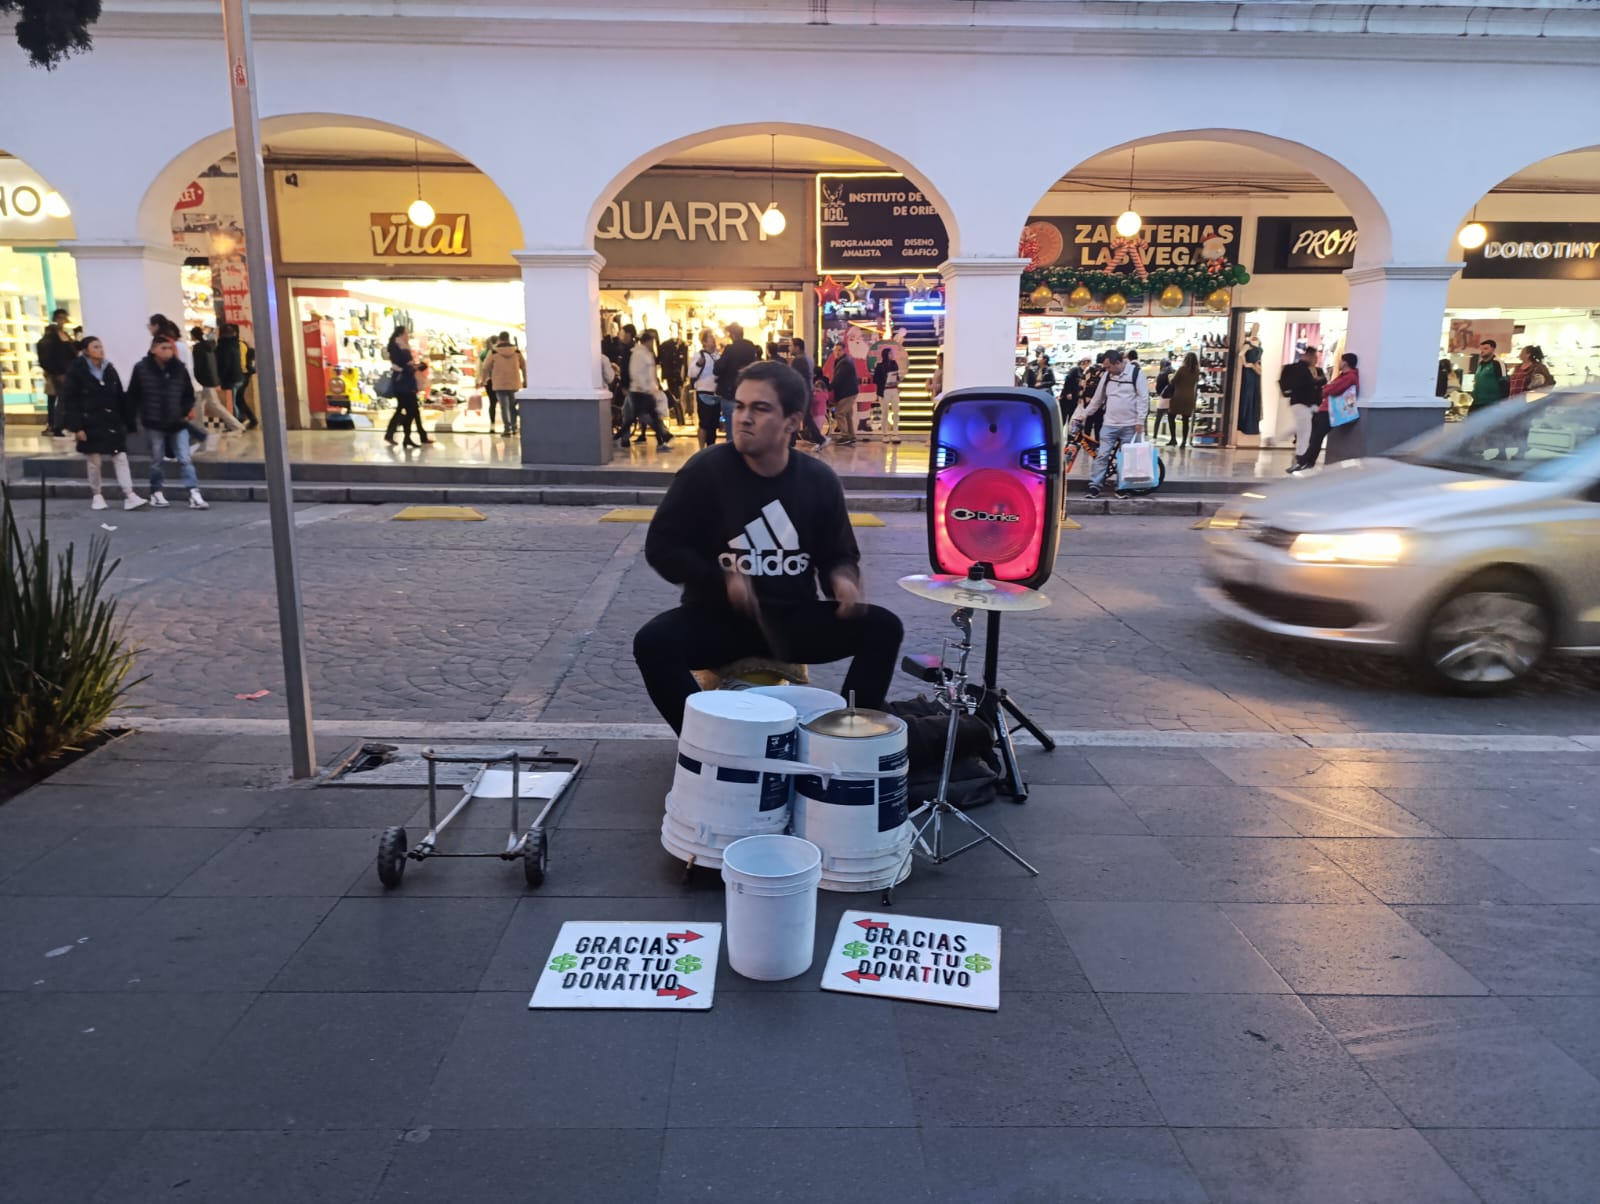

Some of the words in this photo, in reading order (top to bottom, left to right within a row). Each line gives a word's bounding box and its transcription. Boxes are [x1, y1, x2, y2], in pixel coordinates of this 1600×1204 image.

[849, 192, 905, 203] INSTITUTO
[908, 192, 923, 202] DE
[893, 206, 908, 216] DE
[909, 205, 938, 215] ORIE
[596, 200, 779, 241] QUARRY
[830, 239, 893, 248] PROGRAMADOR
[1074, 224, 1234, 245] ZATERIAS
[842, 249, 881, 257] ANALISTA
[1139, 246, 1203, 265] VEG
[1484, 241, 1600, 259] DOROTHY
[718, 548, 811, 576] adidas
[575, 936, 680, 955] GRACIAS
[865, 927, 967, 952] GRACIAS
[580, 956, 630, 971] POR
[641, 957, 672, 972] TU
[872, 946, 921, 964] POR
[931, 952, 961, 968] TU
[562, 972, 679, 991] DONATIVO
[858, 960, 971, 987] DONATIVO
